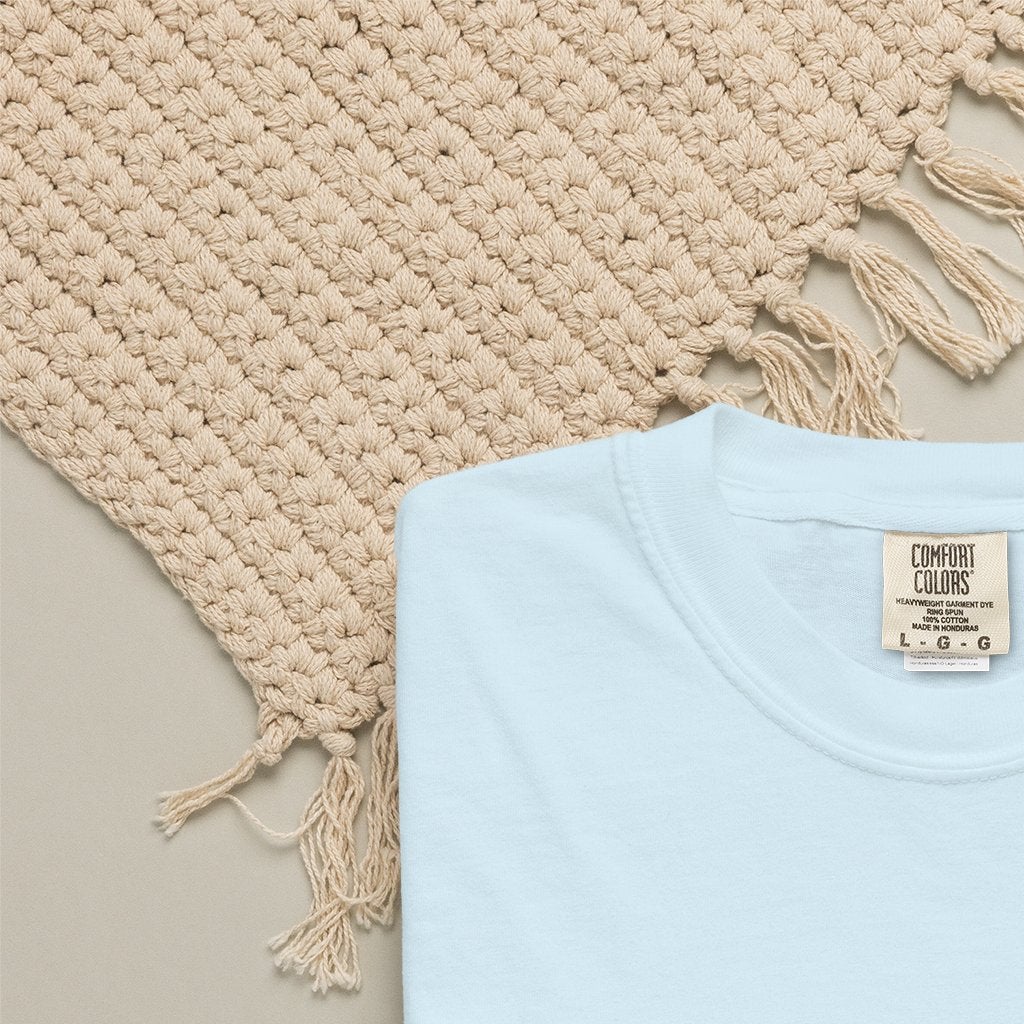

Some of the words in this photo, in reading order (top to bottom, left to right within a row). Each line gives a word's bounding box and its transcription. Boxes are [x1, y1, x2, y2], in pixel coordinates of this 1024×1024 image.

[911, 543, 976, 568] COMFORT
[895, 597, 945, 608] HEAVYWEIGHT
[945, 600, 979, 609] GARMENT
[979, 601, 994, 609] DYE
[926, 608, 944, 616] RING
[944, 608, 964, 616] SPUN
[922, 616, 940, 624] 100%
[940, 616, 969, 624] COTTON
[911, 623, 932, 632] MADE
[932, 624, 940, 632] IN
[941, 624, 979, 632] HONDURAS
[899, 632, 911, 648] L
[936, 635, 951, 650] G
[977, 635, 991, 651] G
